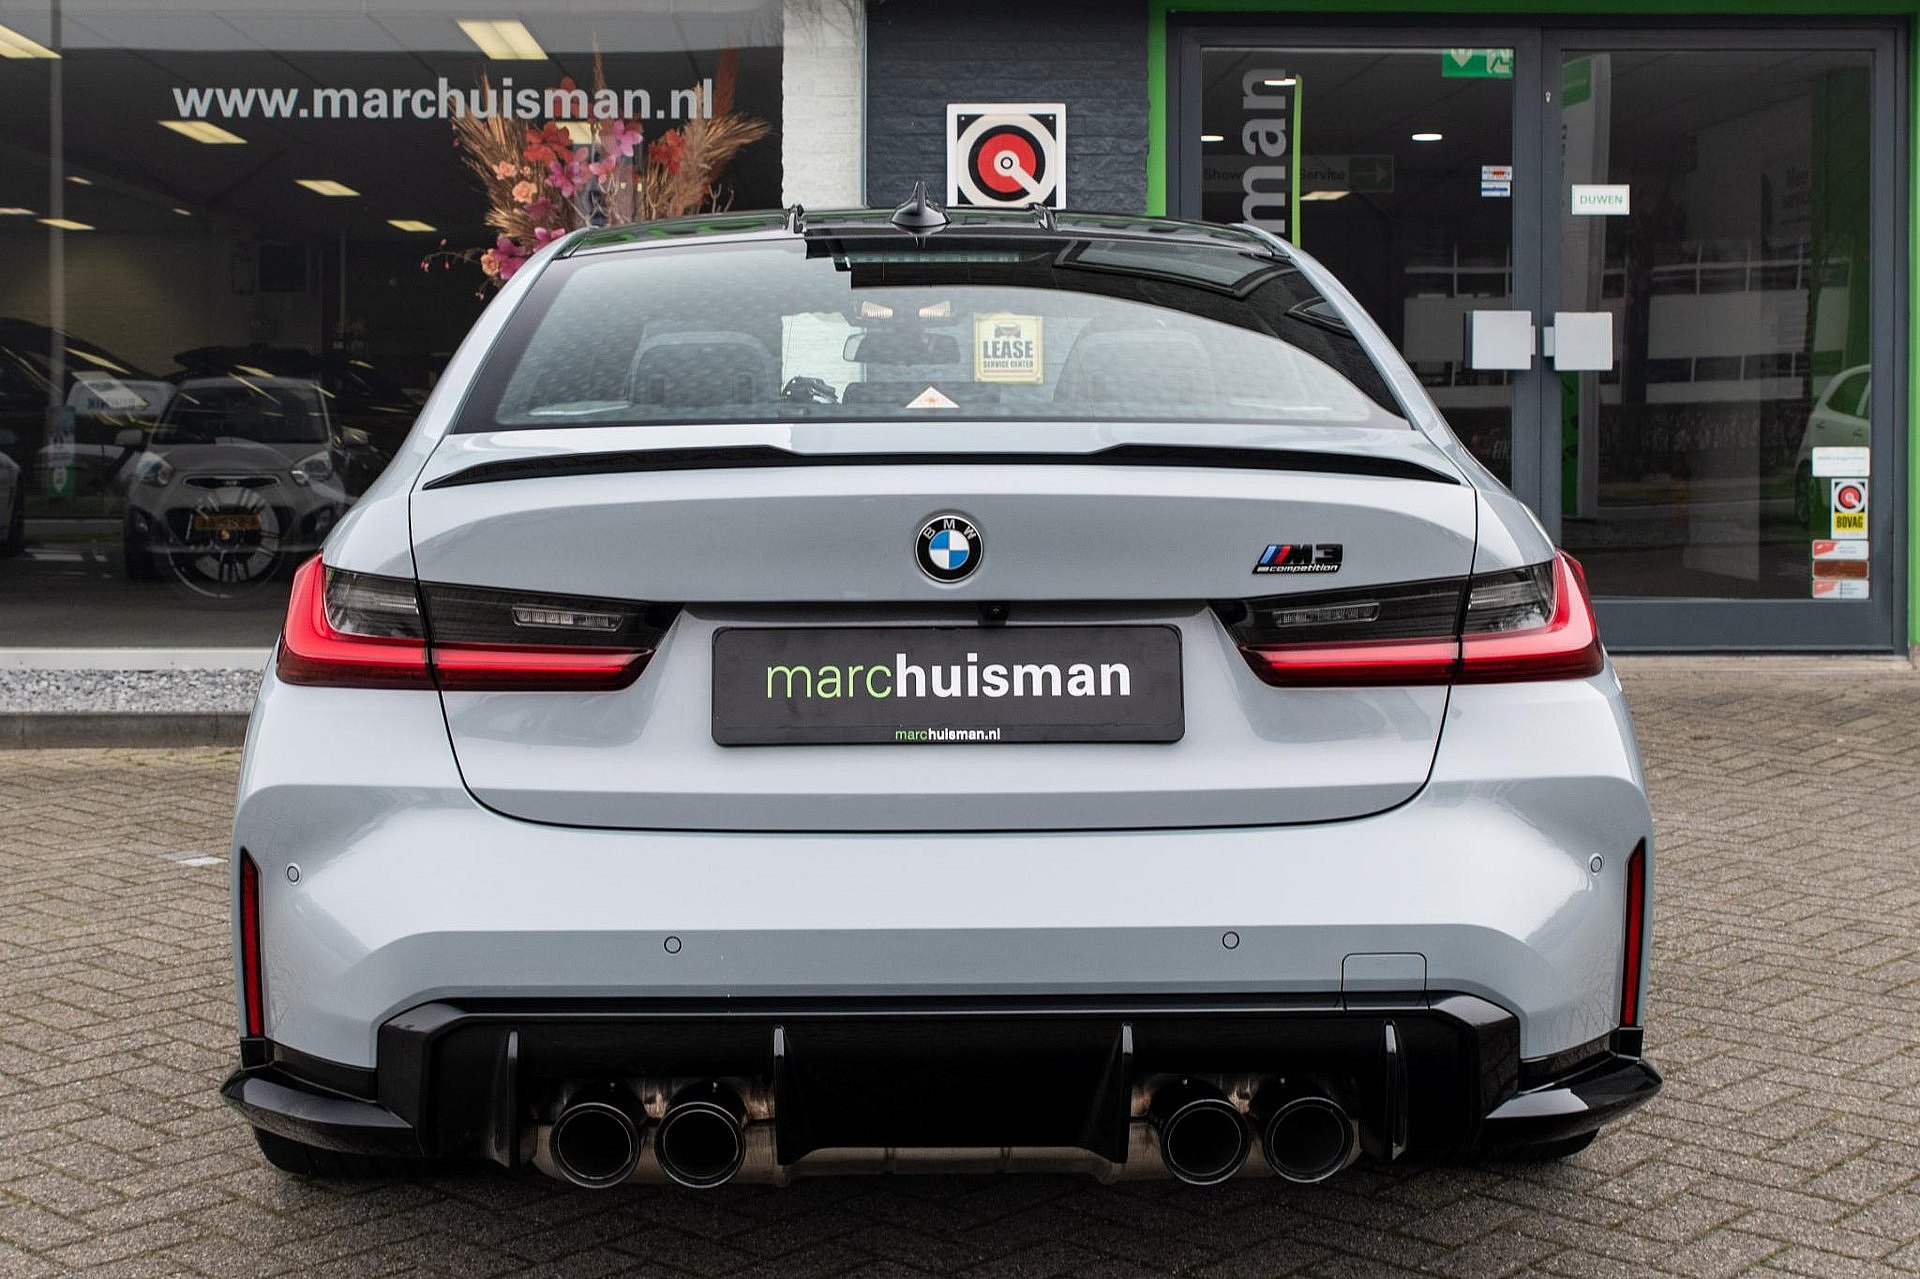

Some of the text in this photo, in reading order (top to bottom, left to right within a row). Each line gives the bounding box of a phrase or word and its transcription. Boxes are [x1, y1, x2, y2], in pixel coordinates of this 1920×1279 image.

[172, 77, 713, 119] www.marchuisman.nl
[1580, 194, 1623, 205] DUWEN
[983, 340, 1033, 359] LEASE
[983, 360, 1034, 369] SERVICE CENTER
[1836, 515, 1864, 529] BOVAG
[923, 519, 977, 540] BMW
[1268, 563, 1339, 574] competition
[766, 652, 1132, 699] marchuisman
[894, 728, 1002, 741] marchuisman.nl
